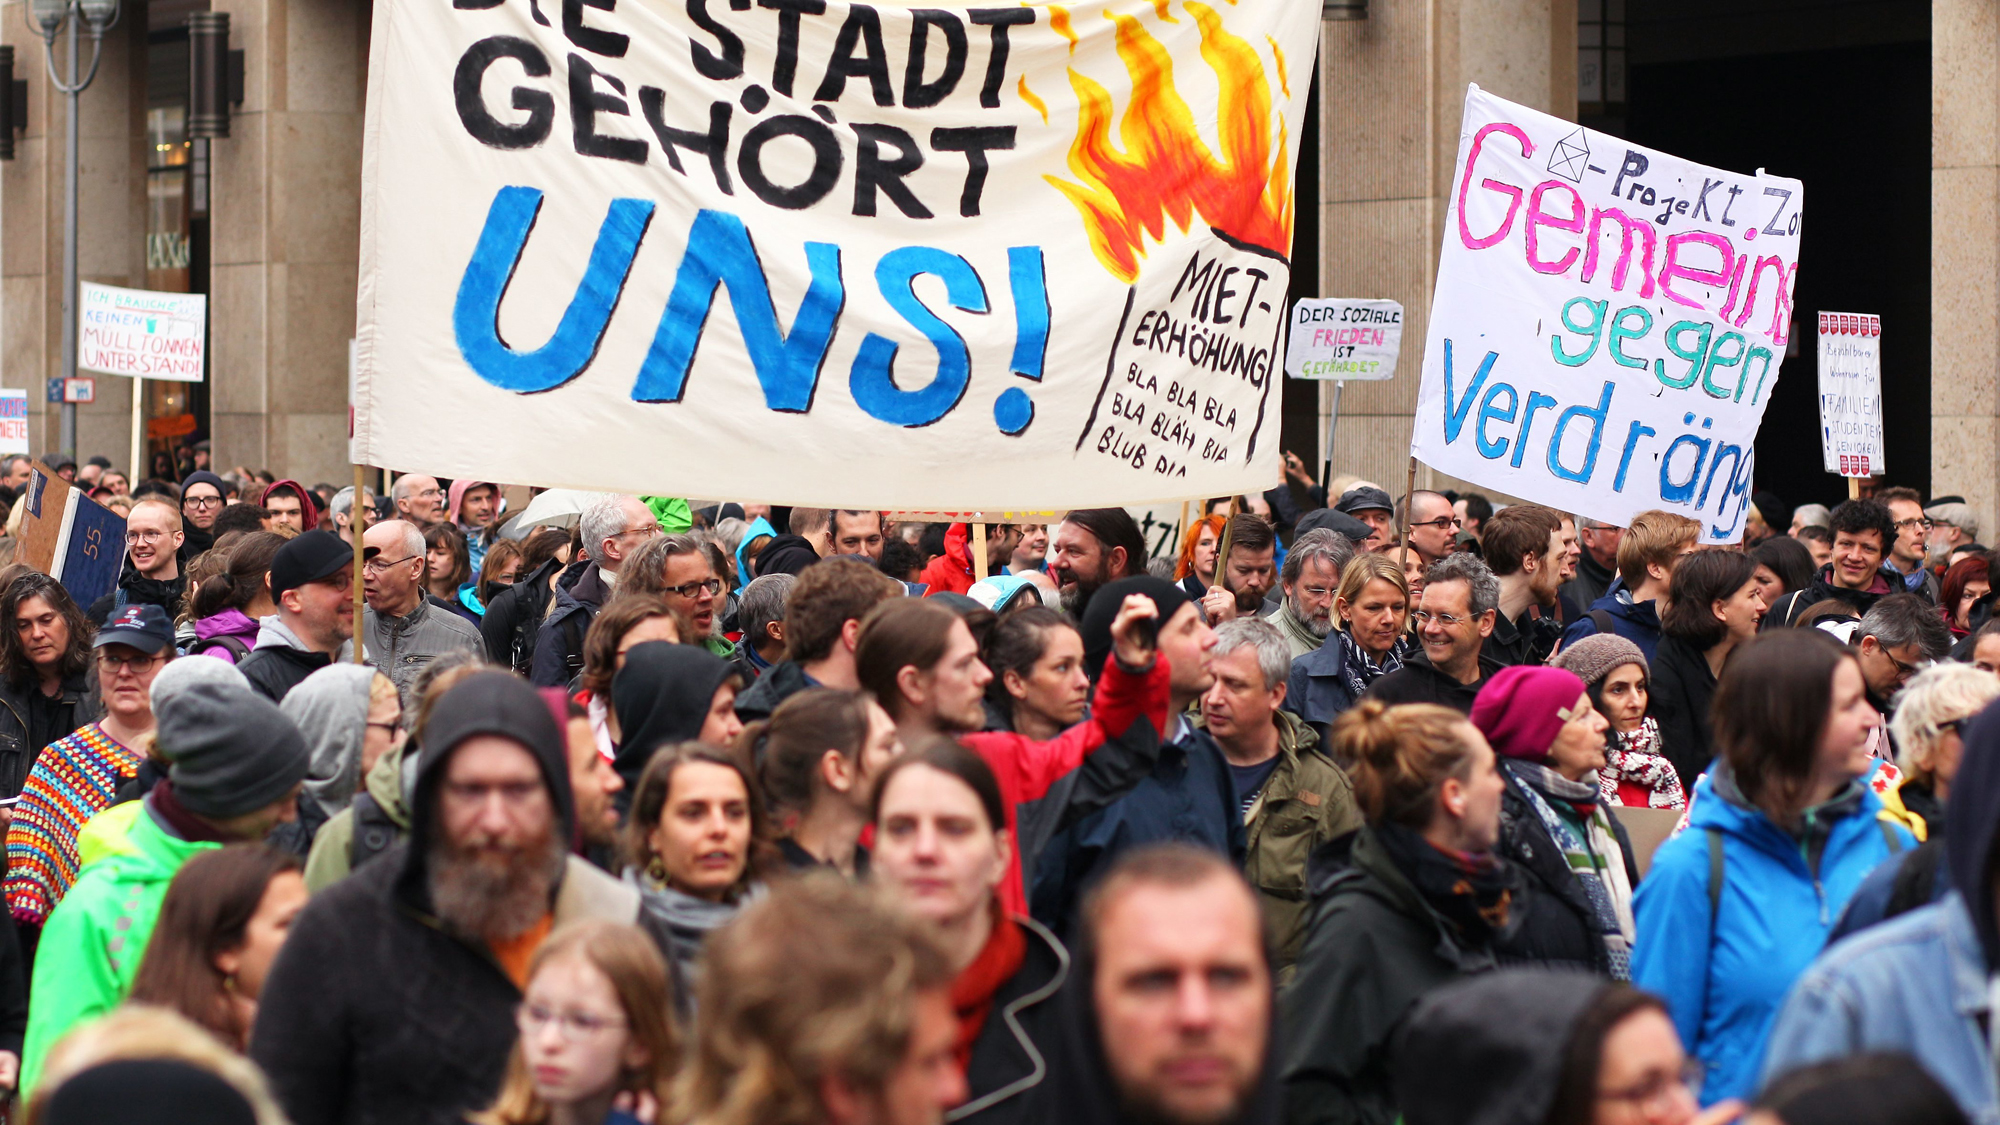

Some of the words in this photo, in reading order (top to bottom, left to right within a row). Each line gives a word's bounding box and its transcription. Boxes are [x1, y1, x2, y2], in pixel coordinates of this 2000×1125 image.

[684, 0, 1037, 109] STADT
[453, 35, 1018, 219] GEHÖRT
[86, 309, 143, 325] KEINEN
[87, 290, 109, 304] ICH
[115, 294, 178, 311] BRAUCHE
[452, 185, 1051, 436] UNS!
[1170, 249, 1272, 329] MIET-
[1299, 307, 1334, 324] DER
[1340, 307, 1400, 324] SOZIALE
[1132, 310, 1268, 392] ERHÖHUNG
[1312, 327, 1385, 347] FRIEDEN
[1333, 346, 1355, 358] IST
[1551, 296, 1773, 406] gegen
[1127, 362, 1158, 395] BLA
[1167, 381, 1197, 415] BLA
[1203, 396, 1237, 433] BLA
[1302, 358, 1380, 377] GEFÄHRDET
[1097, 425, 1147, 469] BLUB
[1111, 392, 1145, 426] BLA
[1150, 411, 1196, 452] BLÄH
[1443, 338, 1754, 540] Verdräng
[1836, 441, 1878, 454] SENIOREN
